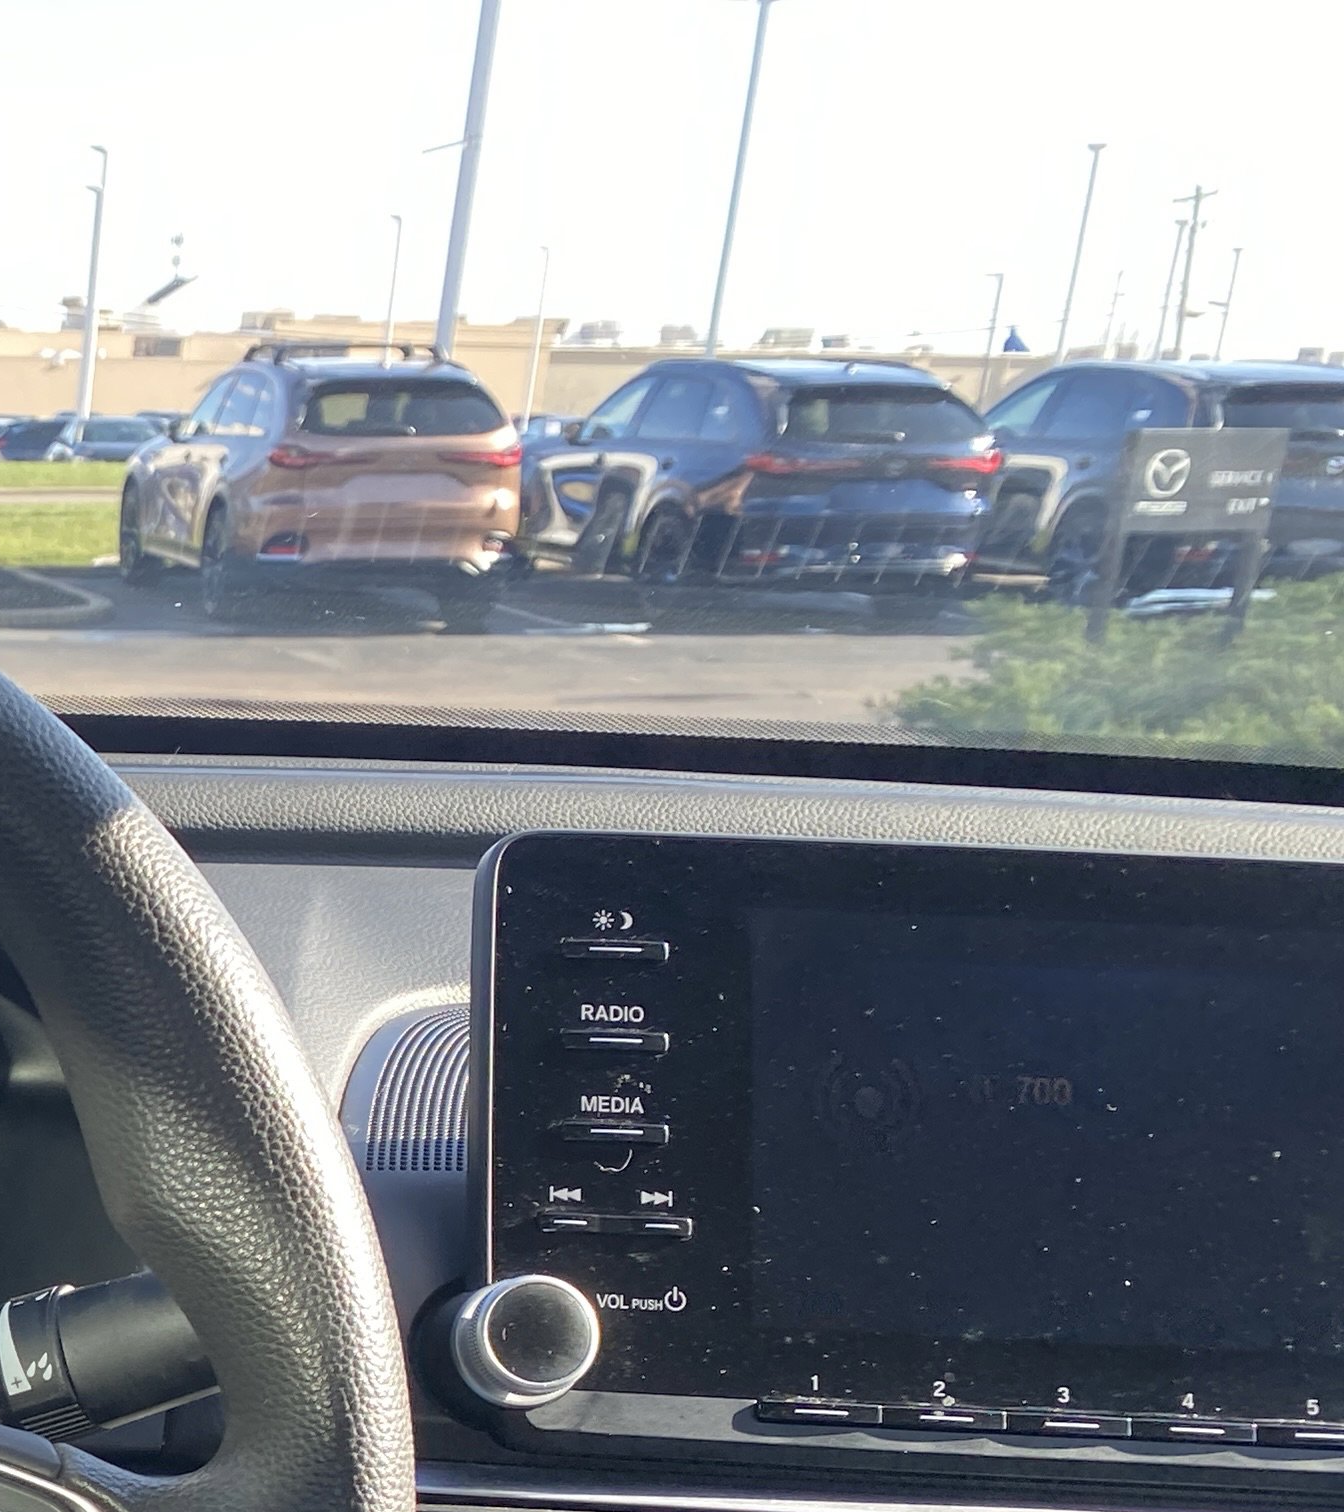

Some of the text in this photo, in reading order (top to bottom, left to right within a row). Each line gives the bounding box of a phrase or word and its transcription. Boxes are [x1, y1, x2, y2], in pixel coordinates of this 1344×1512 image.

[579, 1003, 645, 1025] RADIO
[579, 1094, 645, 1116] MEDIA
[595, 1293, 663, 1313] VOL PUSH
[810, 1374, 820, 1392] 1
[932, 1380, 947, 1401] 2
[1057, 1386, 1071, 1405] 3
[1182, 1393, 1196, 1412] 4
[1307, 1399, 1320, 1418] 5
